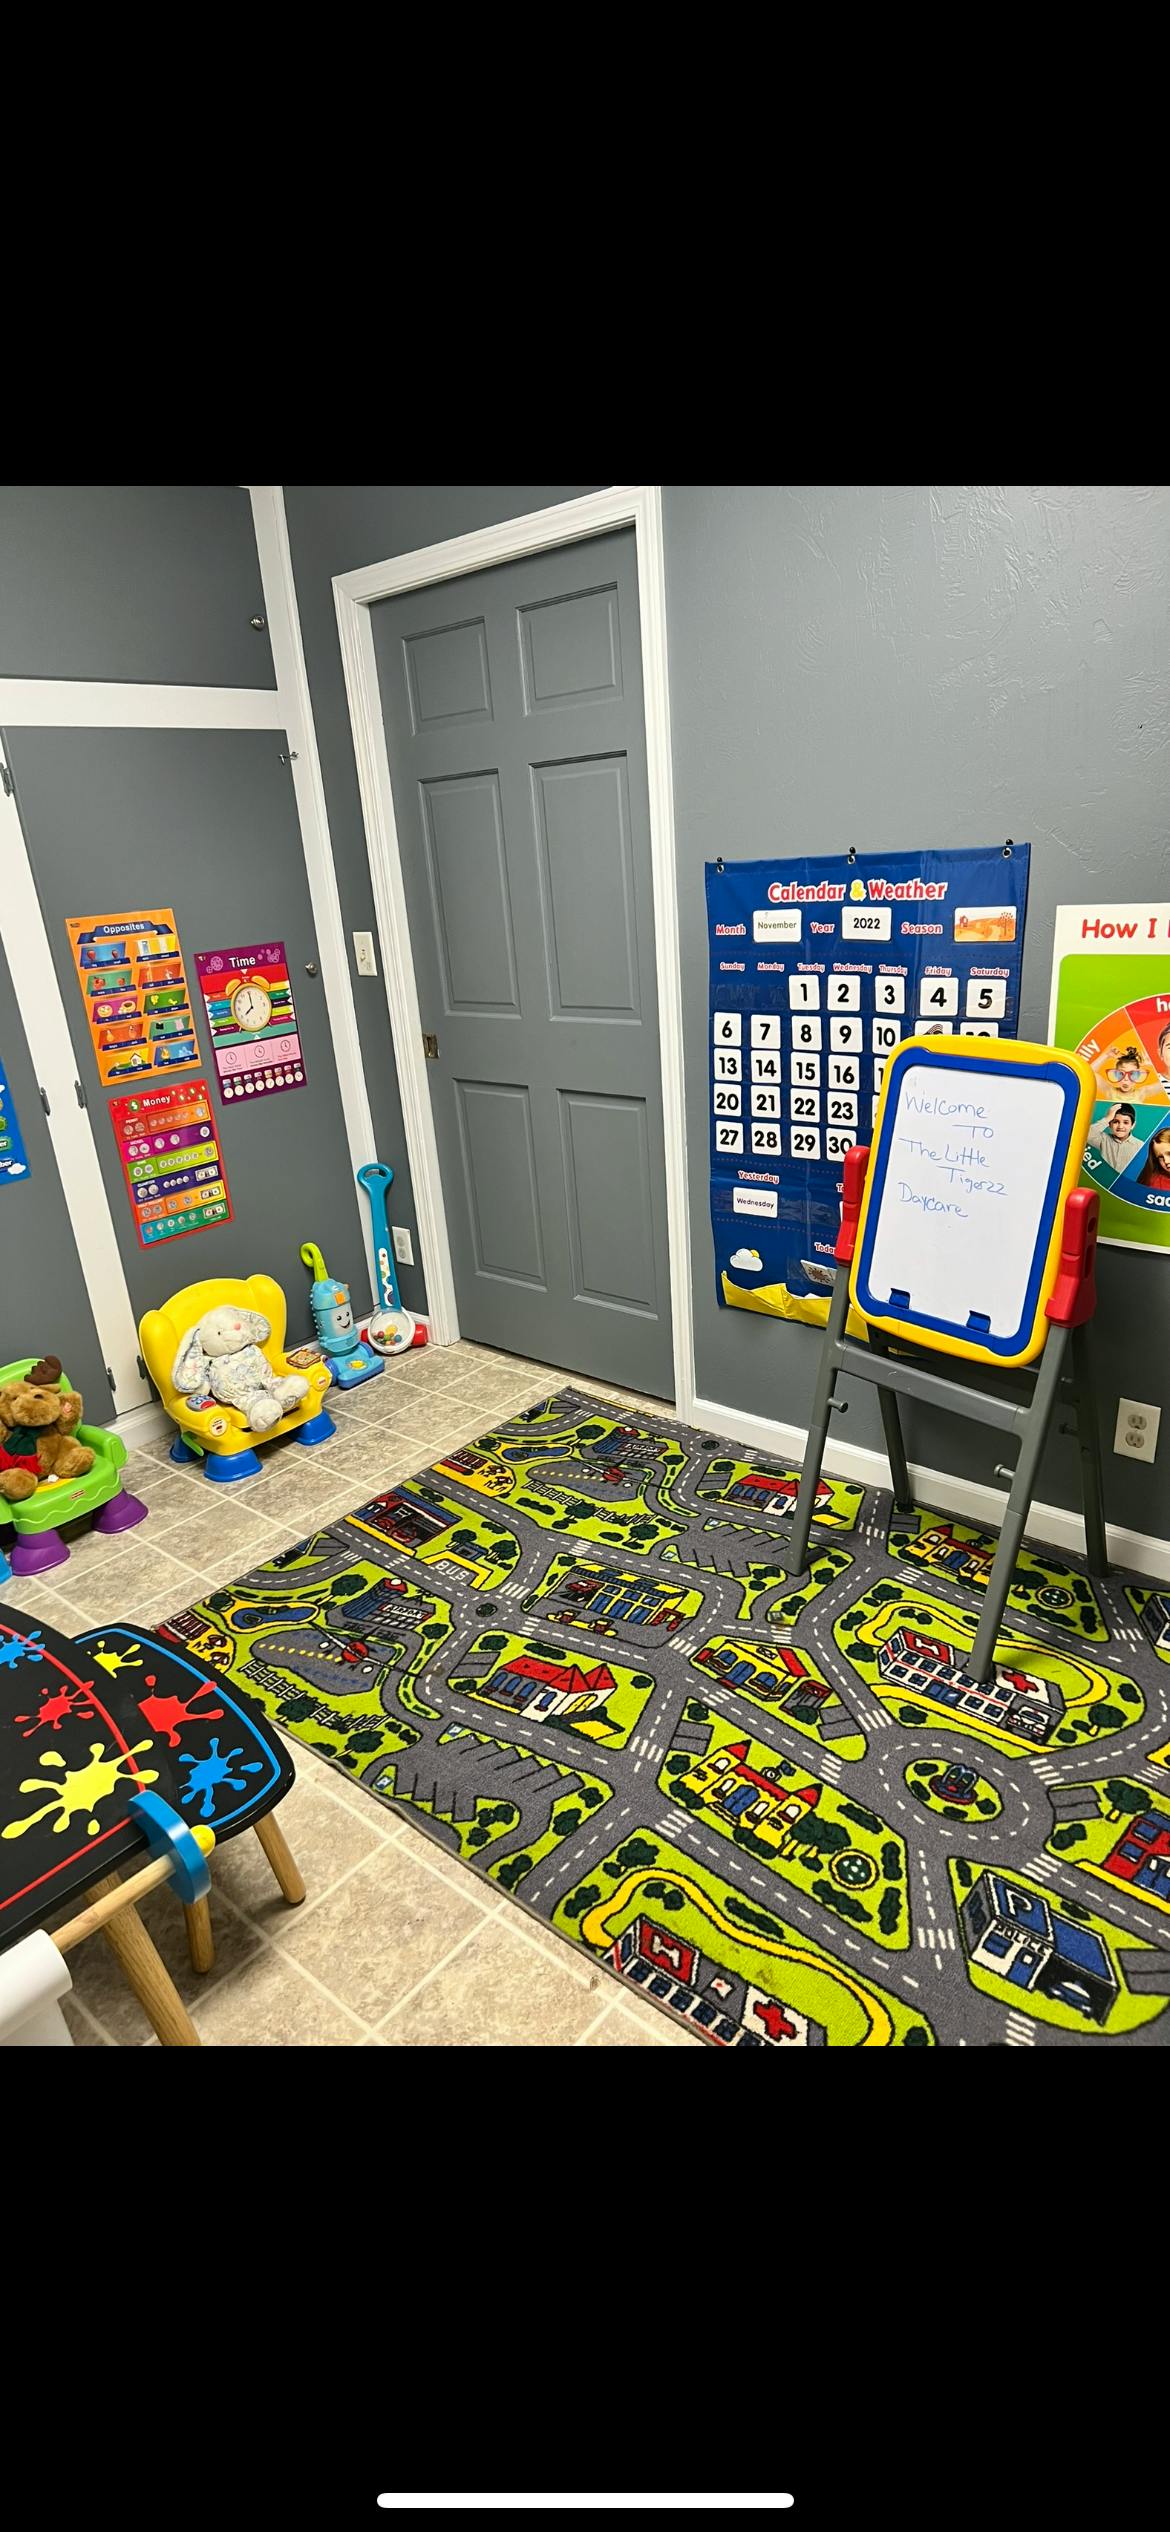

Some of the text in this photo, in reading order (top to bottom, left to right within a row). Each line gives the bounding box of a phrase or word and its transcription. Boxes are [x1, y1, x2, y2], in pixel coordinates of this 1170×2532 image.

[768, 878, 948, 902] Calendar & Weather
[103, 922, 145, 934] Opposites
[715, 924, 746, 935] Month
[758, 921, 797, 930] November
[810, 922, 835, 933] Year
[853, 917, 880, 929] 2022
[901, 922, 943, 934] Season
[1081, 918, 1138, 939] How
[1147, 918, 1157, 938] I
[229, 956, 256, 968] Time
[720, 962, 1009, 977] Sunday Monday Tuesday Wednesday Thursday Friday Saturday
[800, 983, 993, 1009] 1 2 3 4 5
[722, 1020, 896, 1047] 6 7 8 9 10
[719, 1057, 737, 1074] 13
[755, 1059, 777, 1077] 14
[796, 1062, 816, 1080] 15
[834, 1065, 855, 1084] 16
[143, 1095, 171, 1107] Money
[716, 1092, 854, 1120] 20 21 22 23
[719, 1129, 853, 1155] 27 28 29 30
[899, 1138, 990, 1167] The Little
[738, 1170, 779, 1185] Yesterday
[737, 1197, 774, 1209] Wednesday
[814, 1242, 835, 1254] Toda
[435, 1560, 470, 1580] BUS
